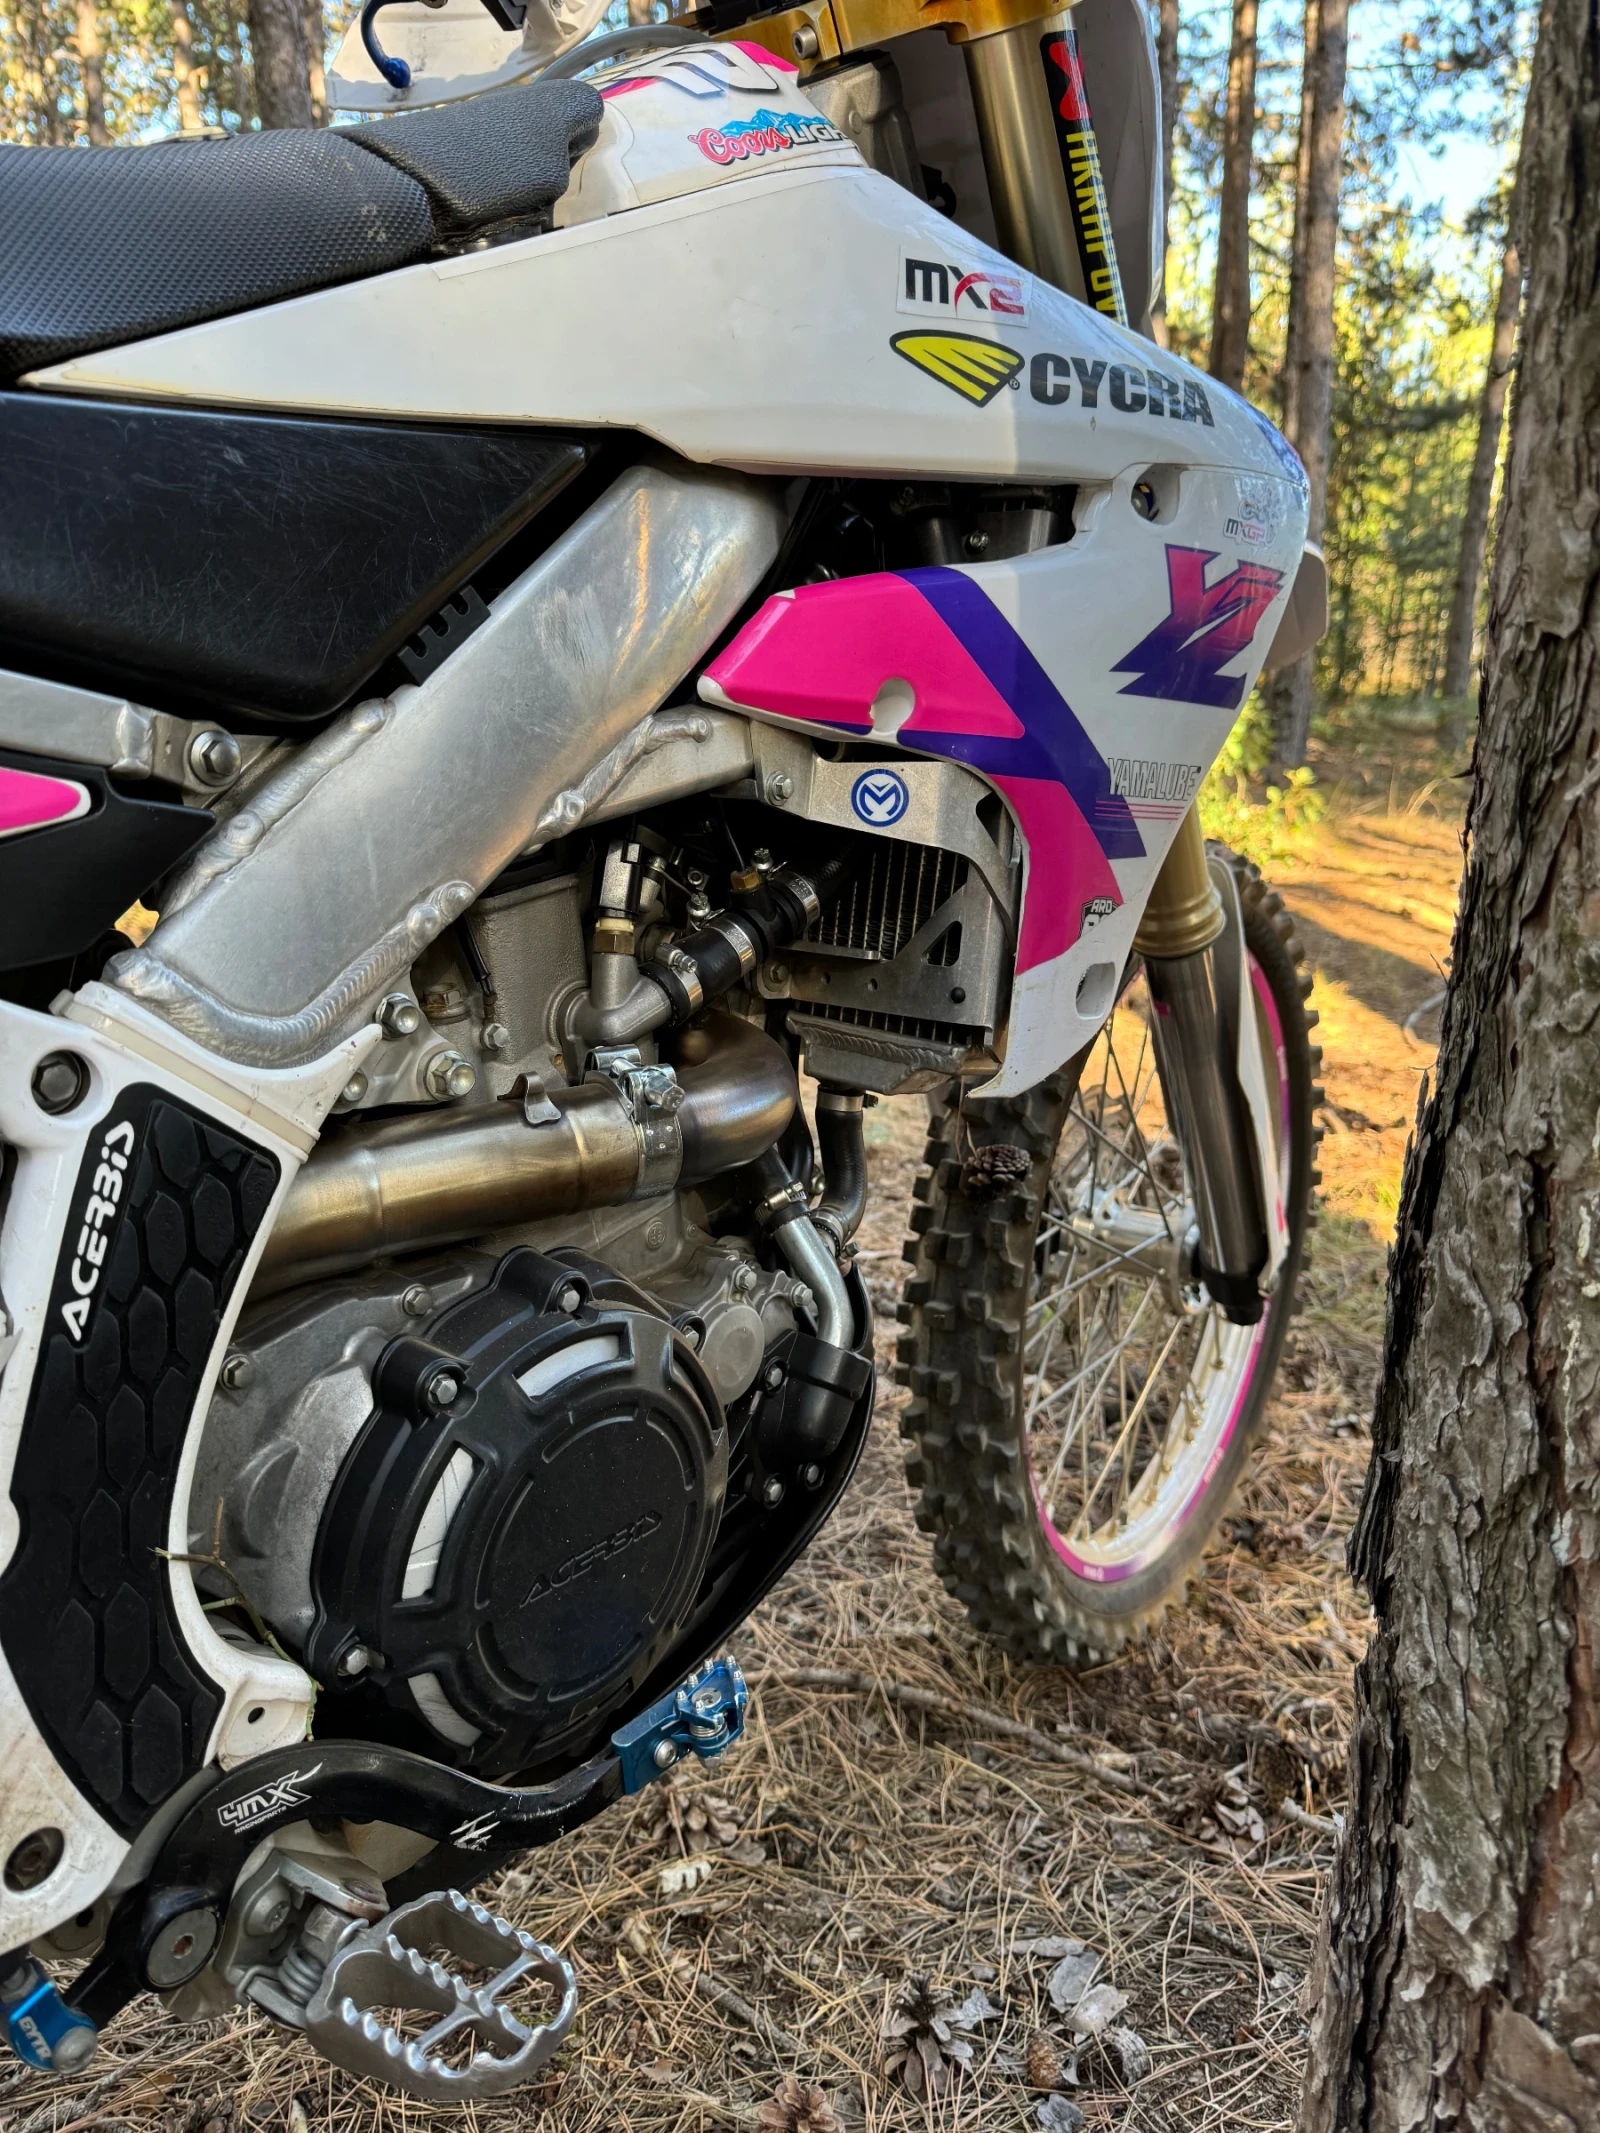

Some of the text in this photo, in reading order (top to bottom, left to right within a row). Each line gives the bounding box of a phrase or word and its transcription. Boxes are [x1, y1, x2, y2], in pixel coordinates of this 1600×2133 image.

[687, 122, 848, 166] Coors LIGH
[1029, 352, 1215, 428] CYCRA
[1107, 757, 1200, 802] YAMALUBE
[61, 1120, 136, 1343] ACERBIS
